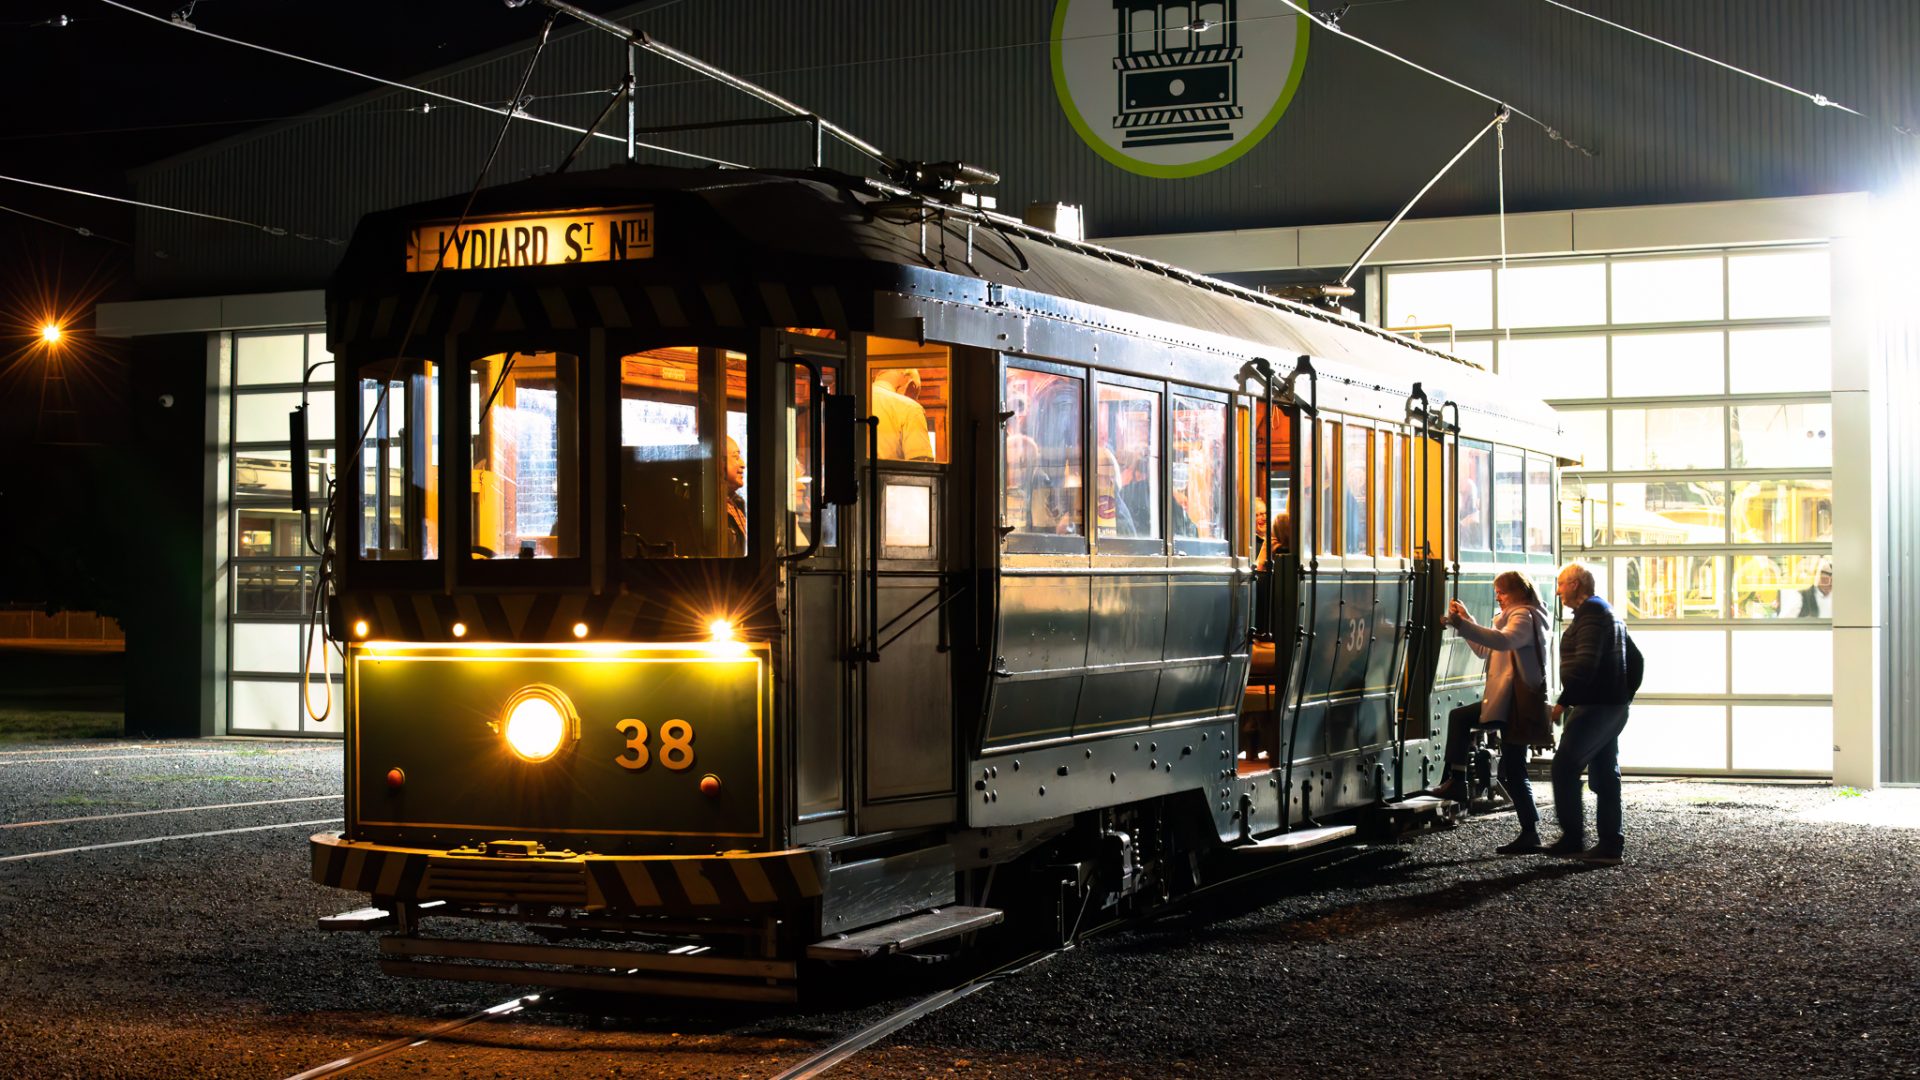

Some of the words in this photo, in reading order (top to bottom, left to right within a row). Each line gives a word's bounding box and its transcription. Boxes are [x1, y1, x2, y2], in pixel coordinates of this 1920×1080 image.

[437, 226, 549, 270] LYDIARD
[564, 222, 594, 263] ST
[610, 219, 651, 261] NTH
[1346, 617, 1365, 652] 38
[615, 718, 695, 770] 38
